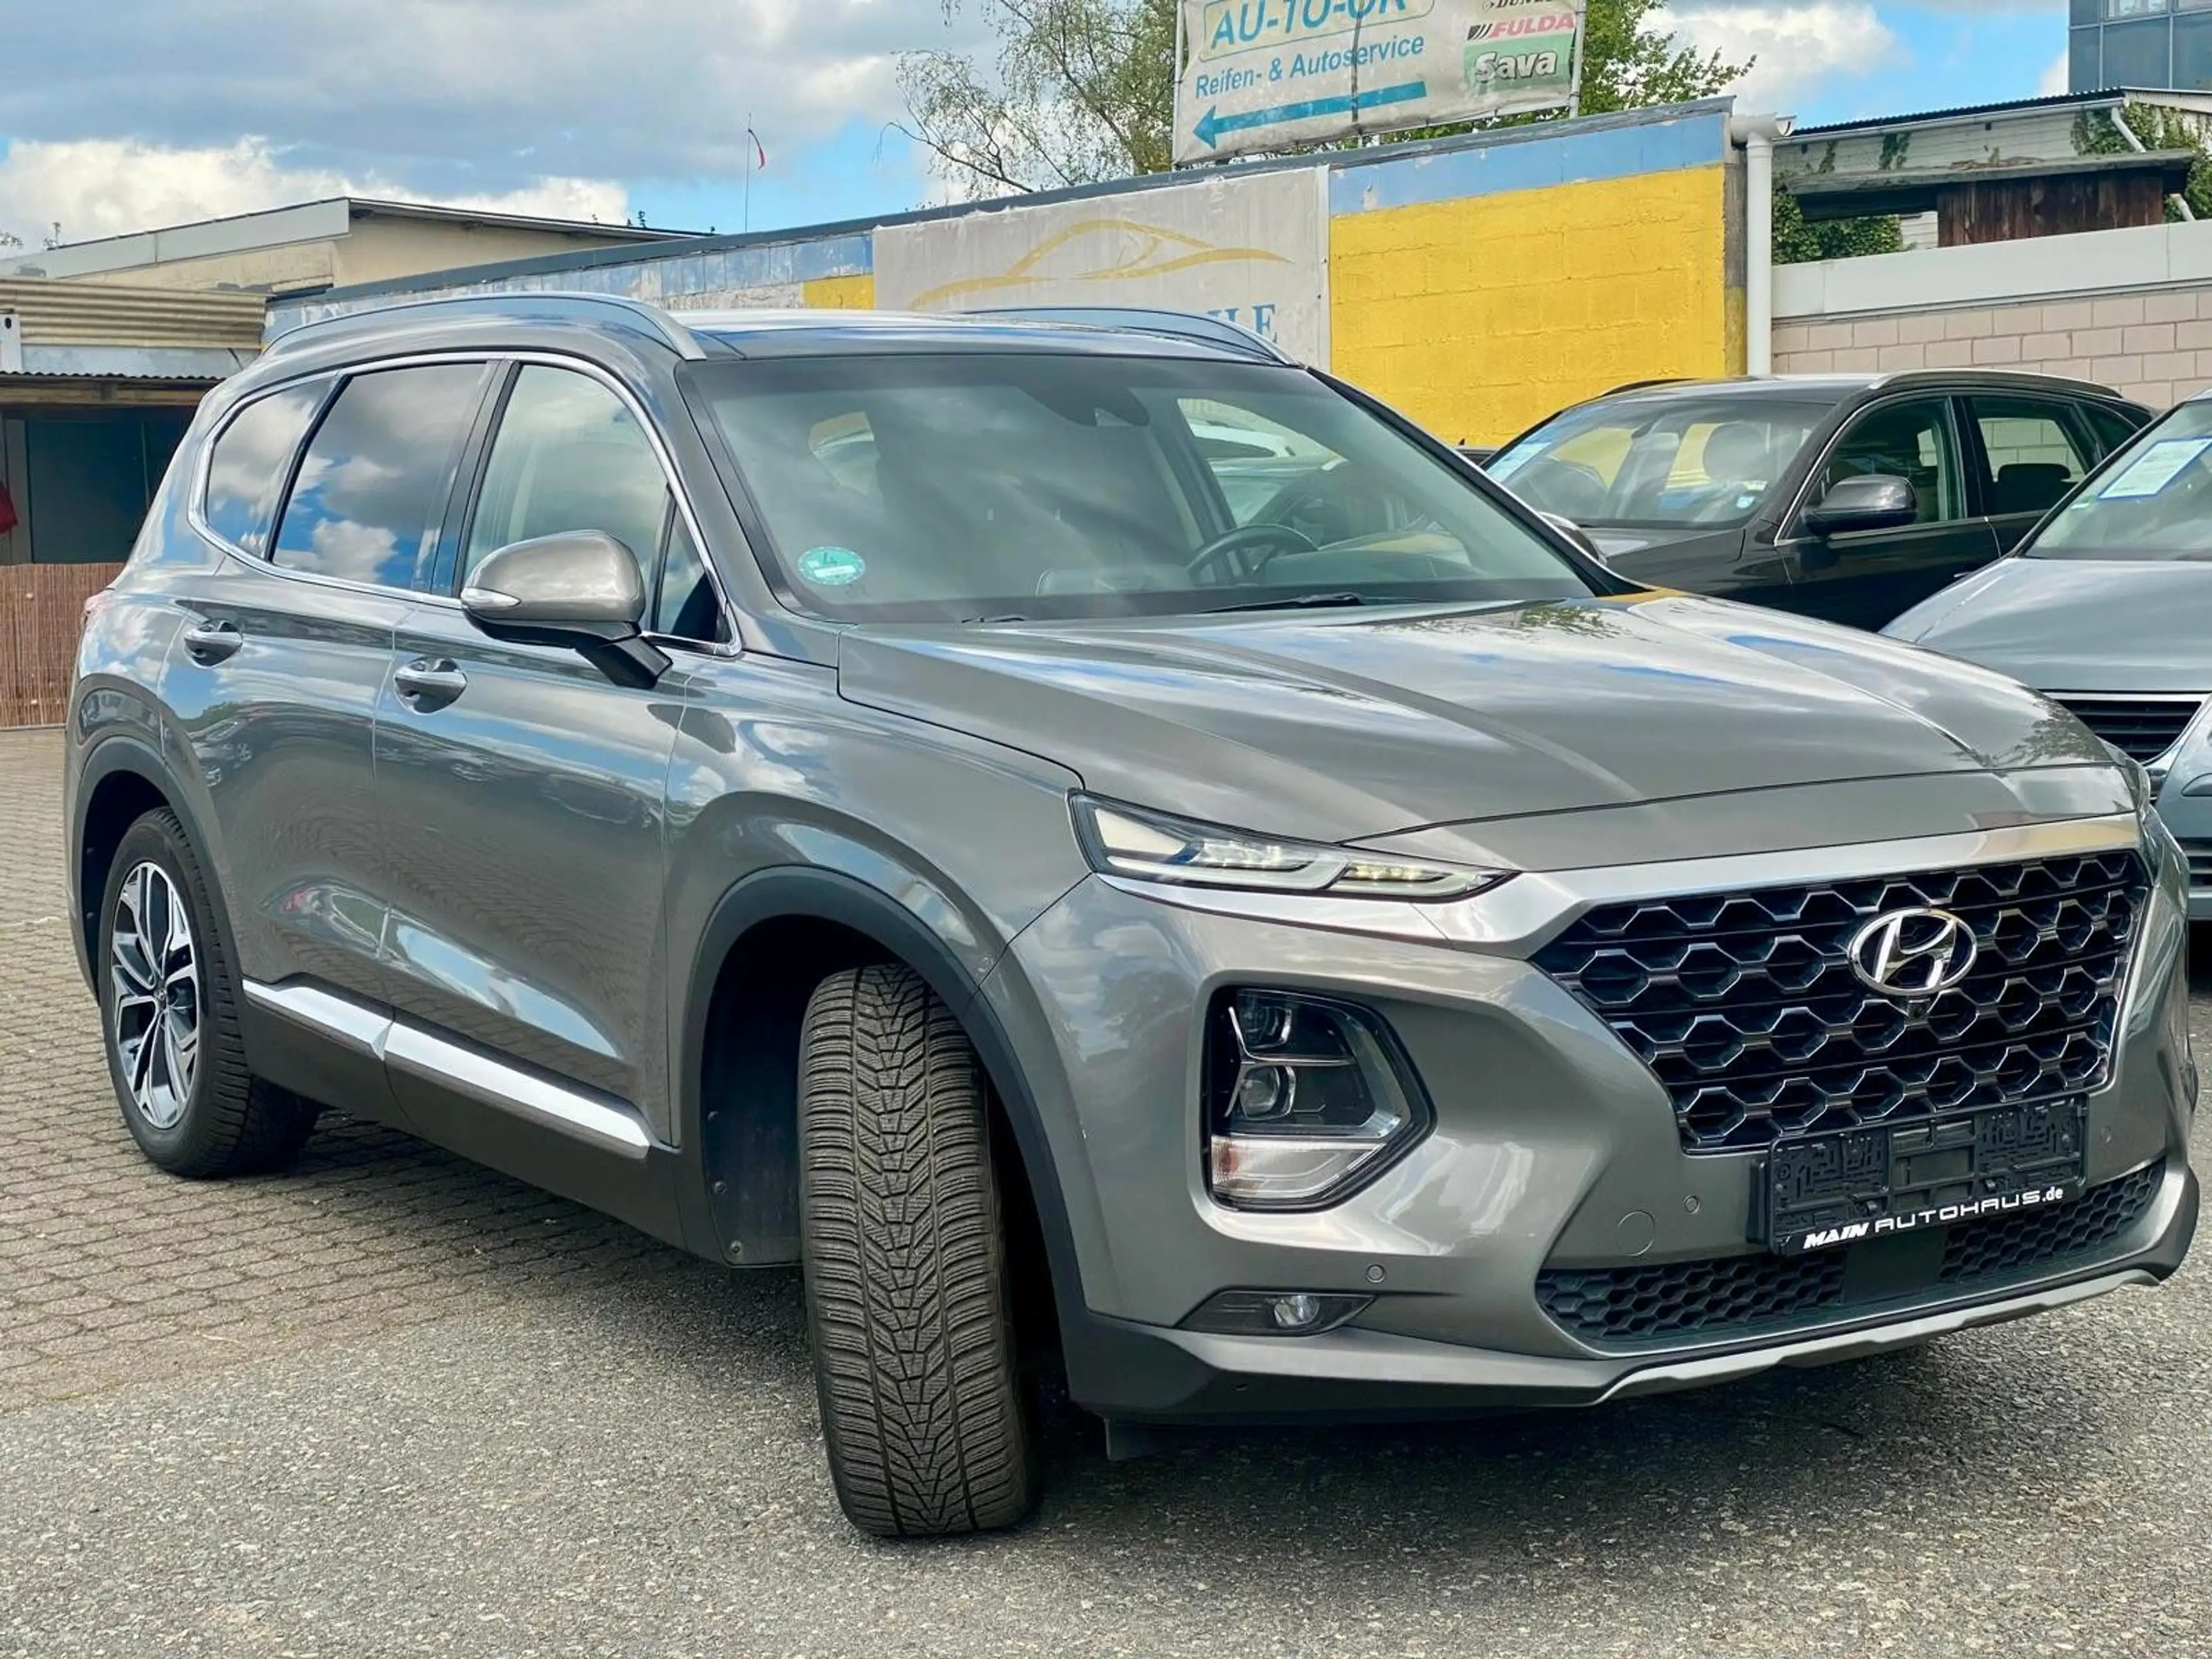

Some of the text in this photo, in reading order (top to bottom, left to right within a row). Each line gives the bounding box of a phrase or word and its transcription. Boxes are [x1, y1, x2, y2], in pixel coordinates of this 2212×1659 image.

[1488, 13, 1575, 39] FULDA
[1196, 35, 1424, 99] Reifen- & Autoservice
[1474, 50, 1558, 84] Sava
[1802, 1185, 2064, 1249] MAIN AUTOHAUS.de
